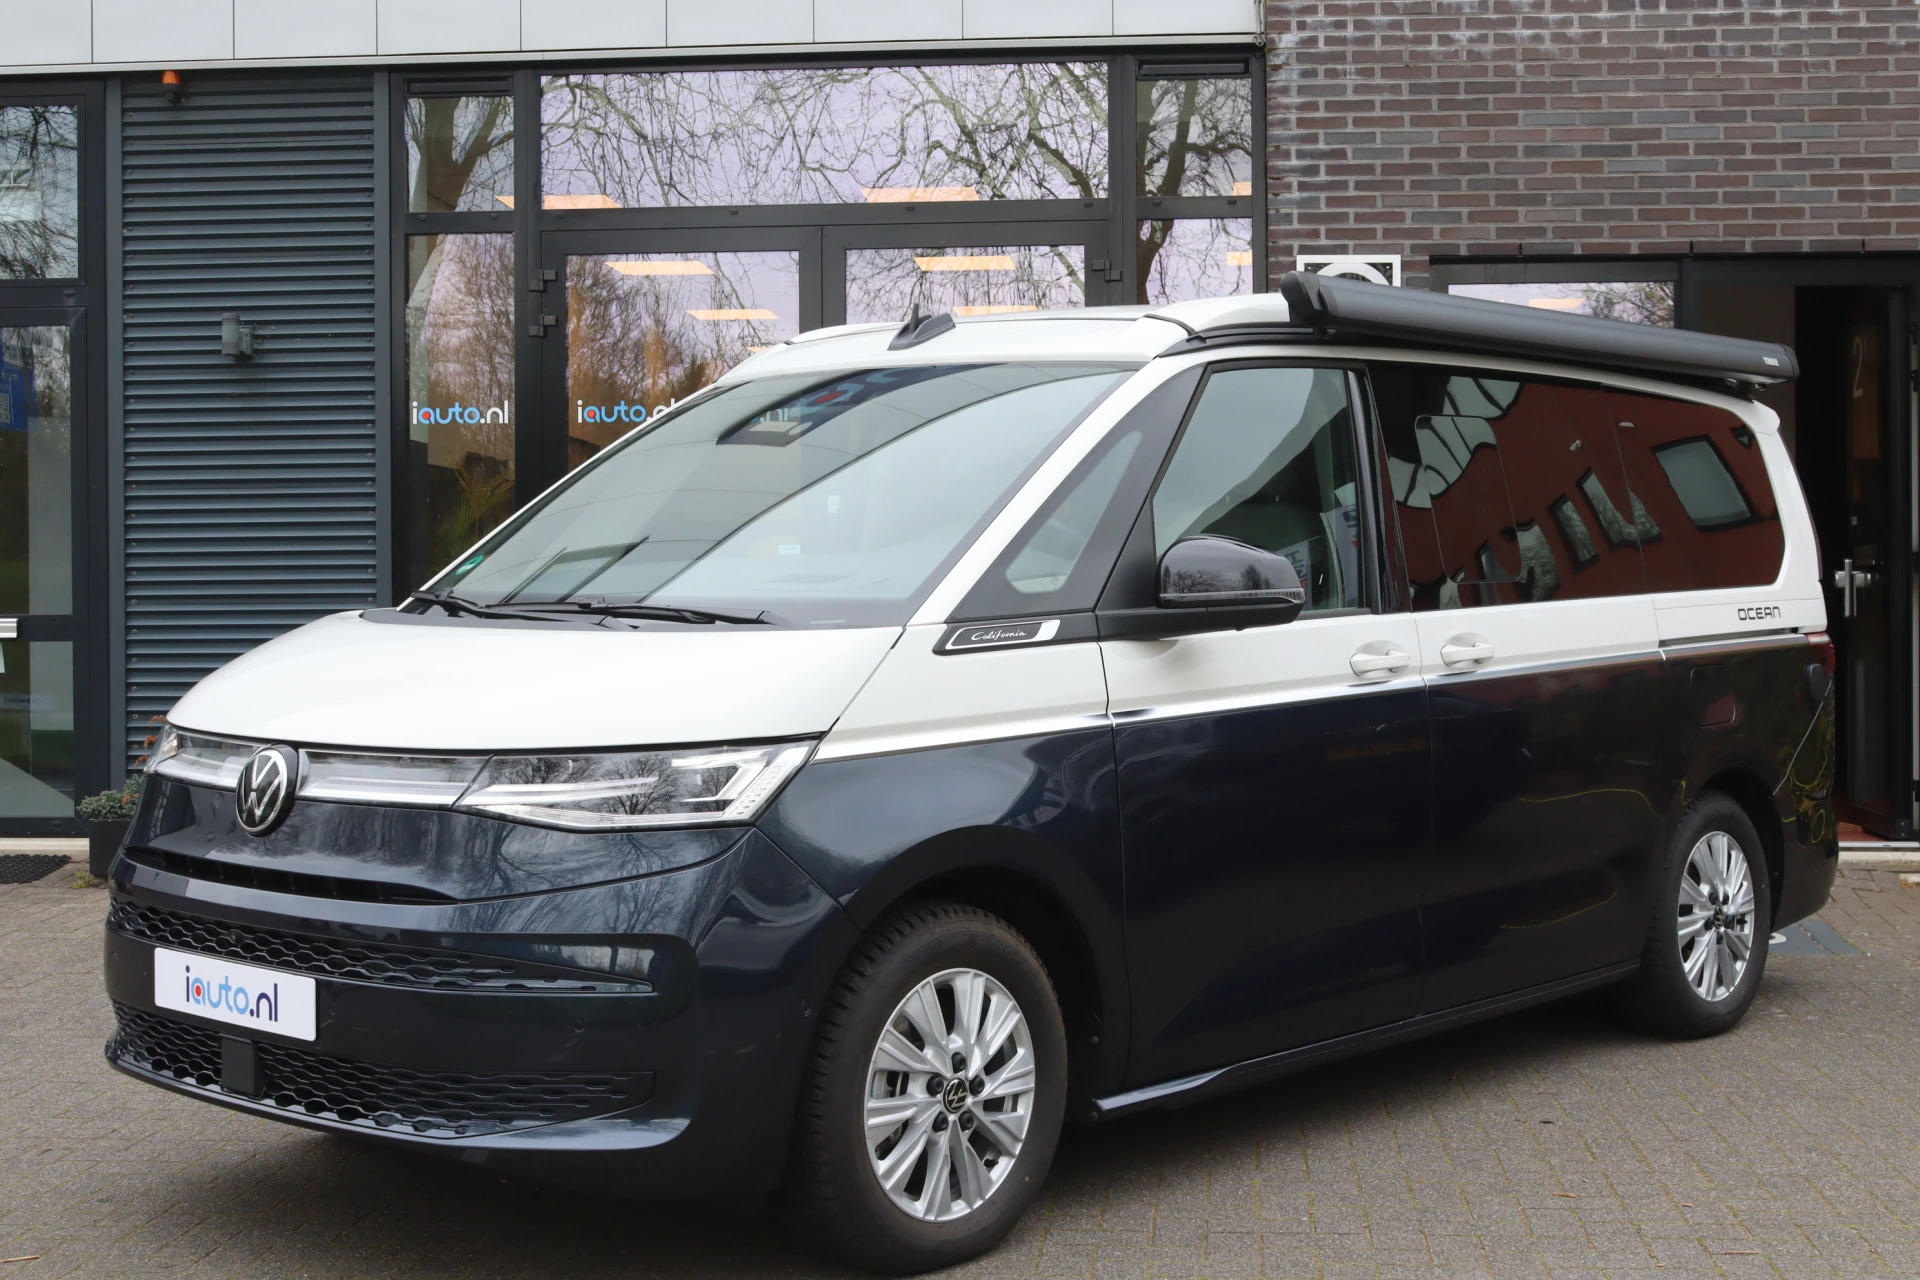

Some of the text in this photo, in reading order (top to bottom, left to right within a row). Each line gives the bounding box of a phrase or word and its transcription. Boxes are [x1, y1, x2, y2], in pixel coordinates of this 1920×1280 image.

[412, 400, 509, 424] iauto.nl
[1737, 606, 1781, 620] OCEAN
[971, 629, 1027, 641] California
[185, 965, 279, 1022] iauto.nl
